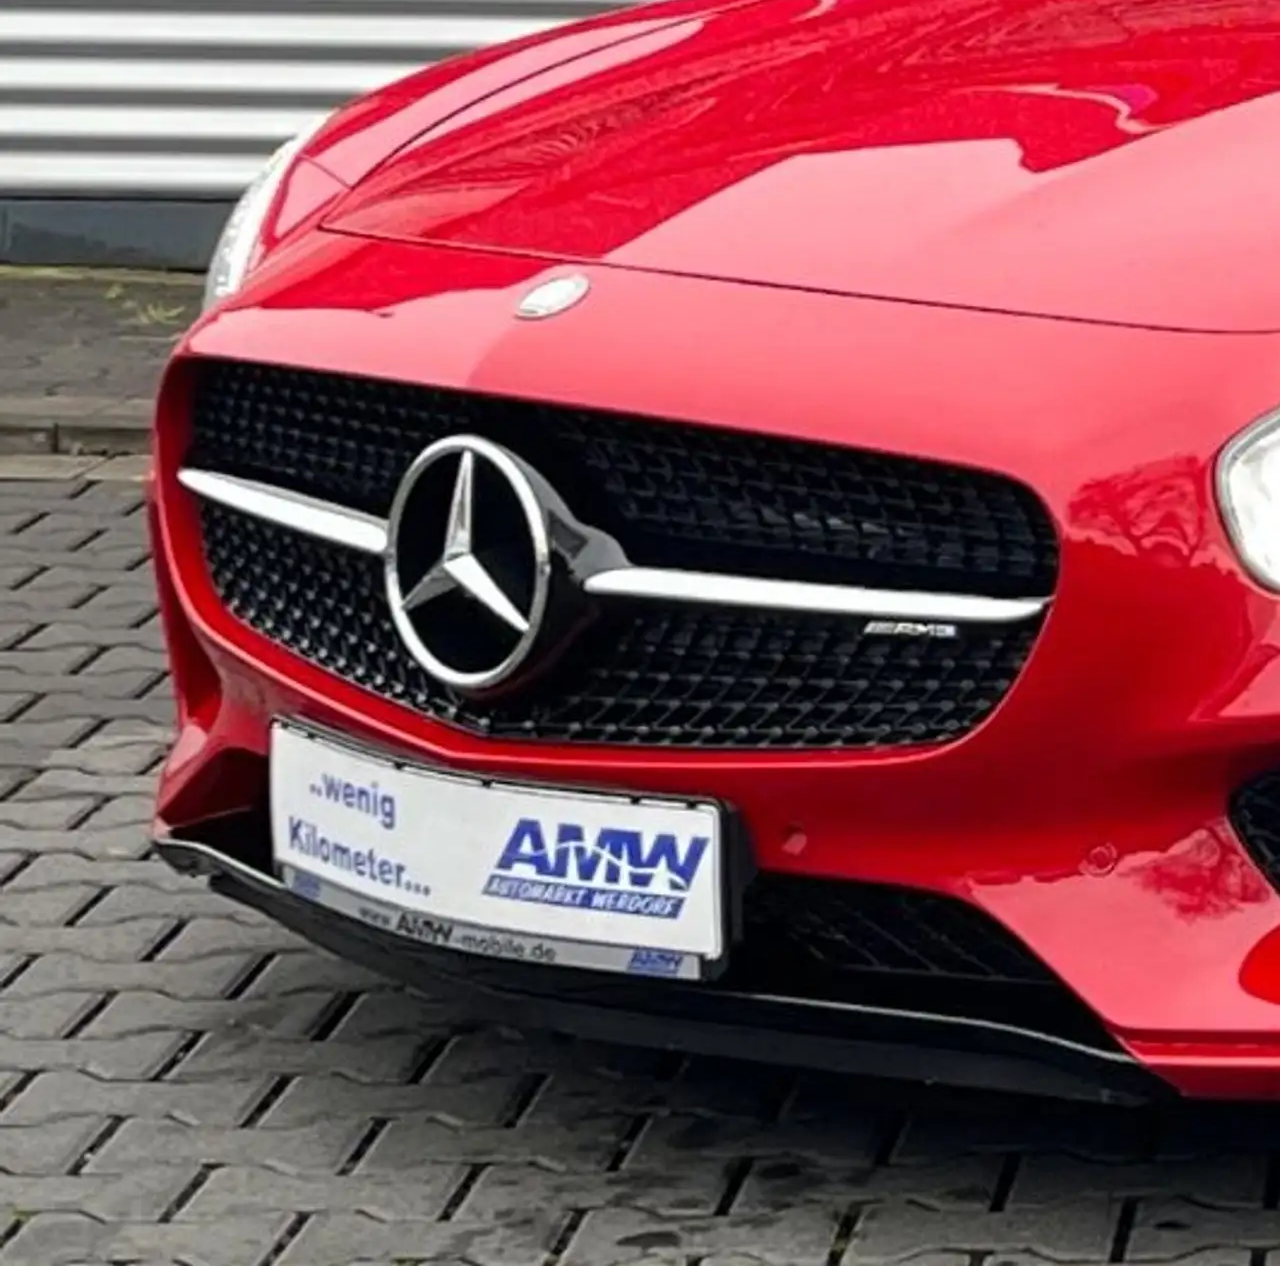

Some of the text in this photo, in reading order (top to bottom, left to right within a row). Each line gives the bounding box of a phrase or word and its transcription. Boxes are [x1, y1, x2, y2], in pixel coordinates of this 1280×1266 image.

[496, 817, 710, 892] AMW
[487, 877, 679, 916] AUTOMARKT WERDORF
